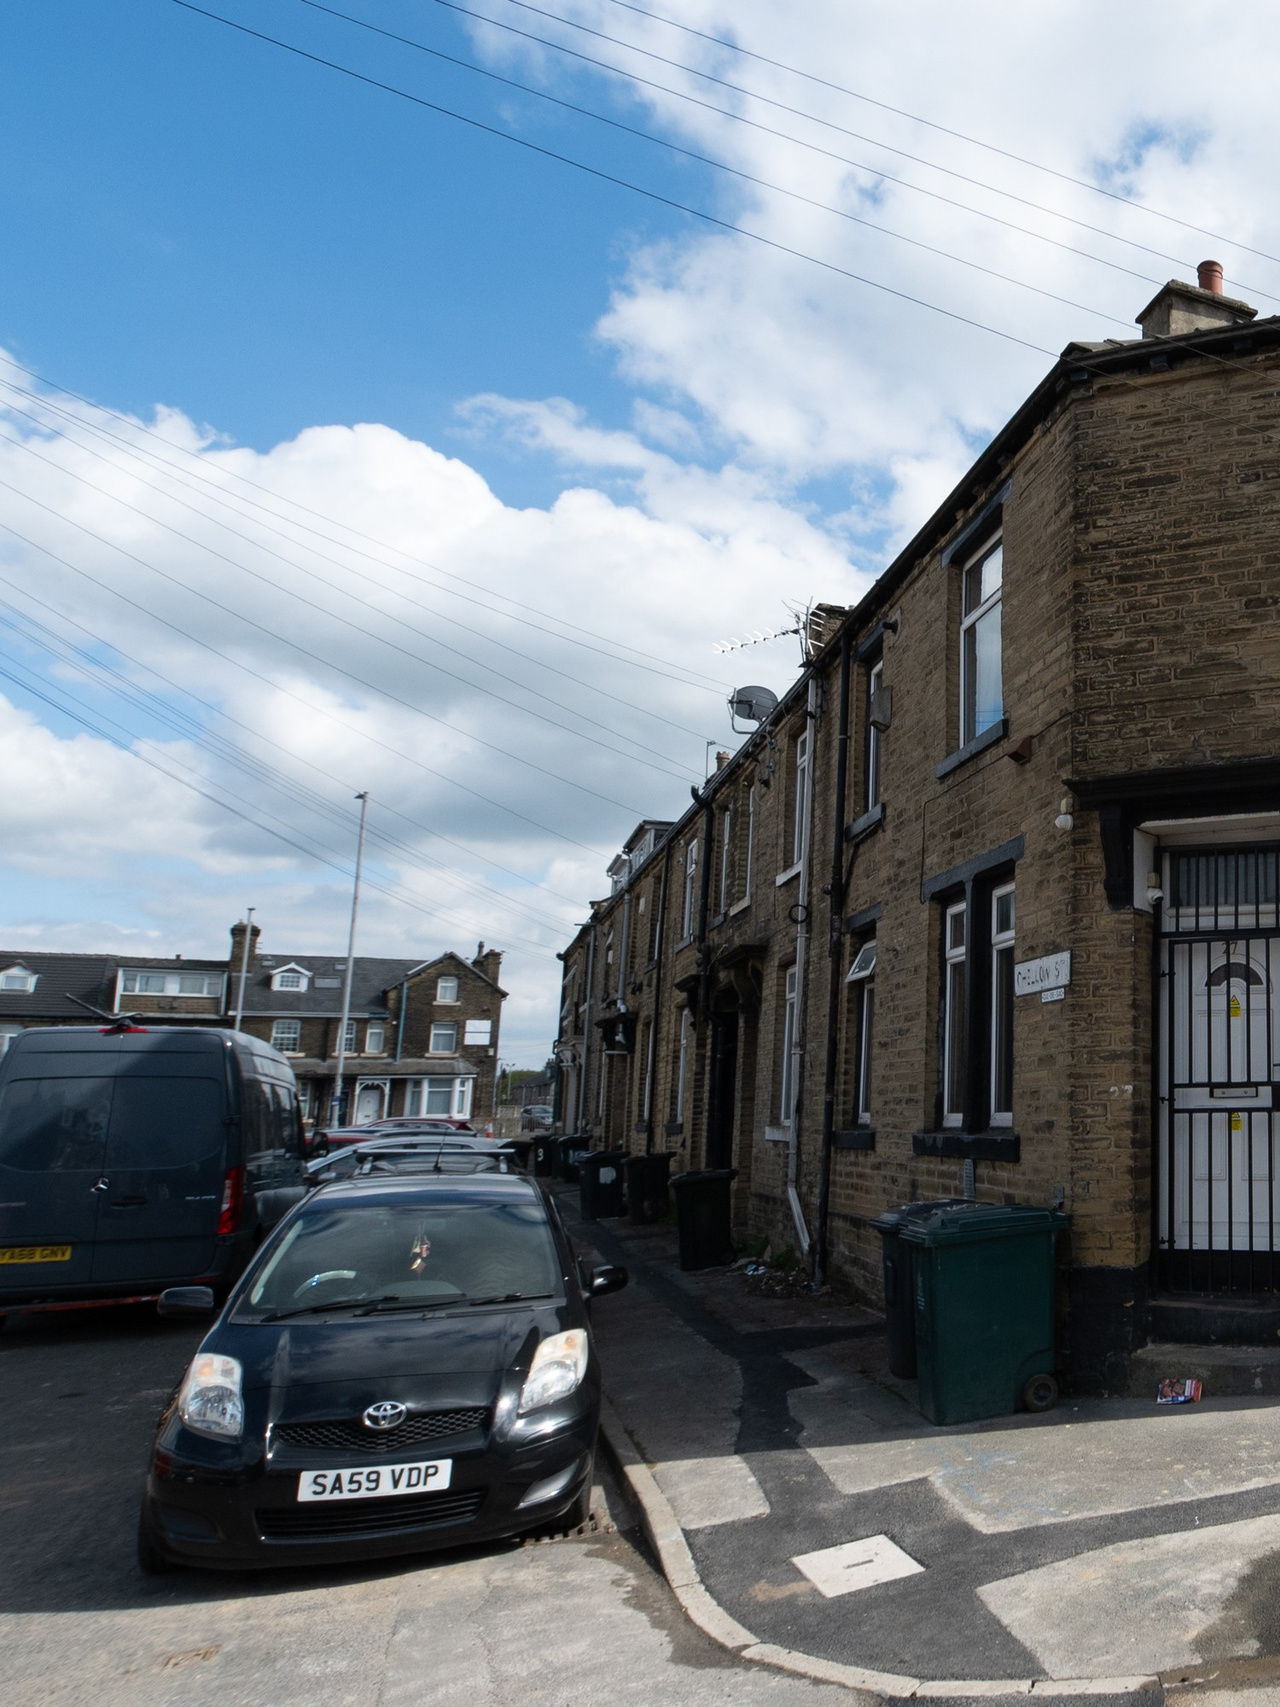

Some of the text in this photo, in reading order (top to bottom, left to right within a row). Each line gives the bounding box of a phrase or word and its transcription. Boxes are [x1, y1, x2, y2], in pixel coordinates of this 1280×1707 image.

[1221, 941, 1238, 955] 27
[1016, 964, 1050, 987] CELOW
[311, 1464, 439, 1496] SA59 VDP
